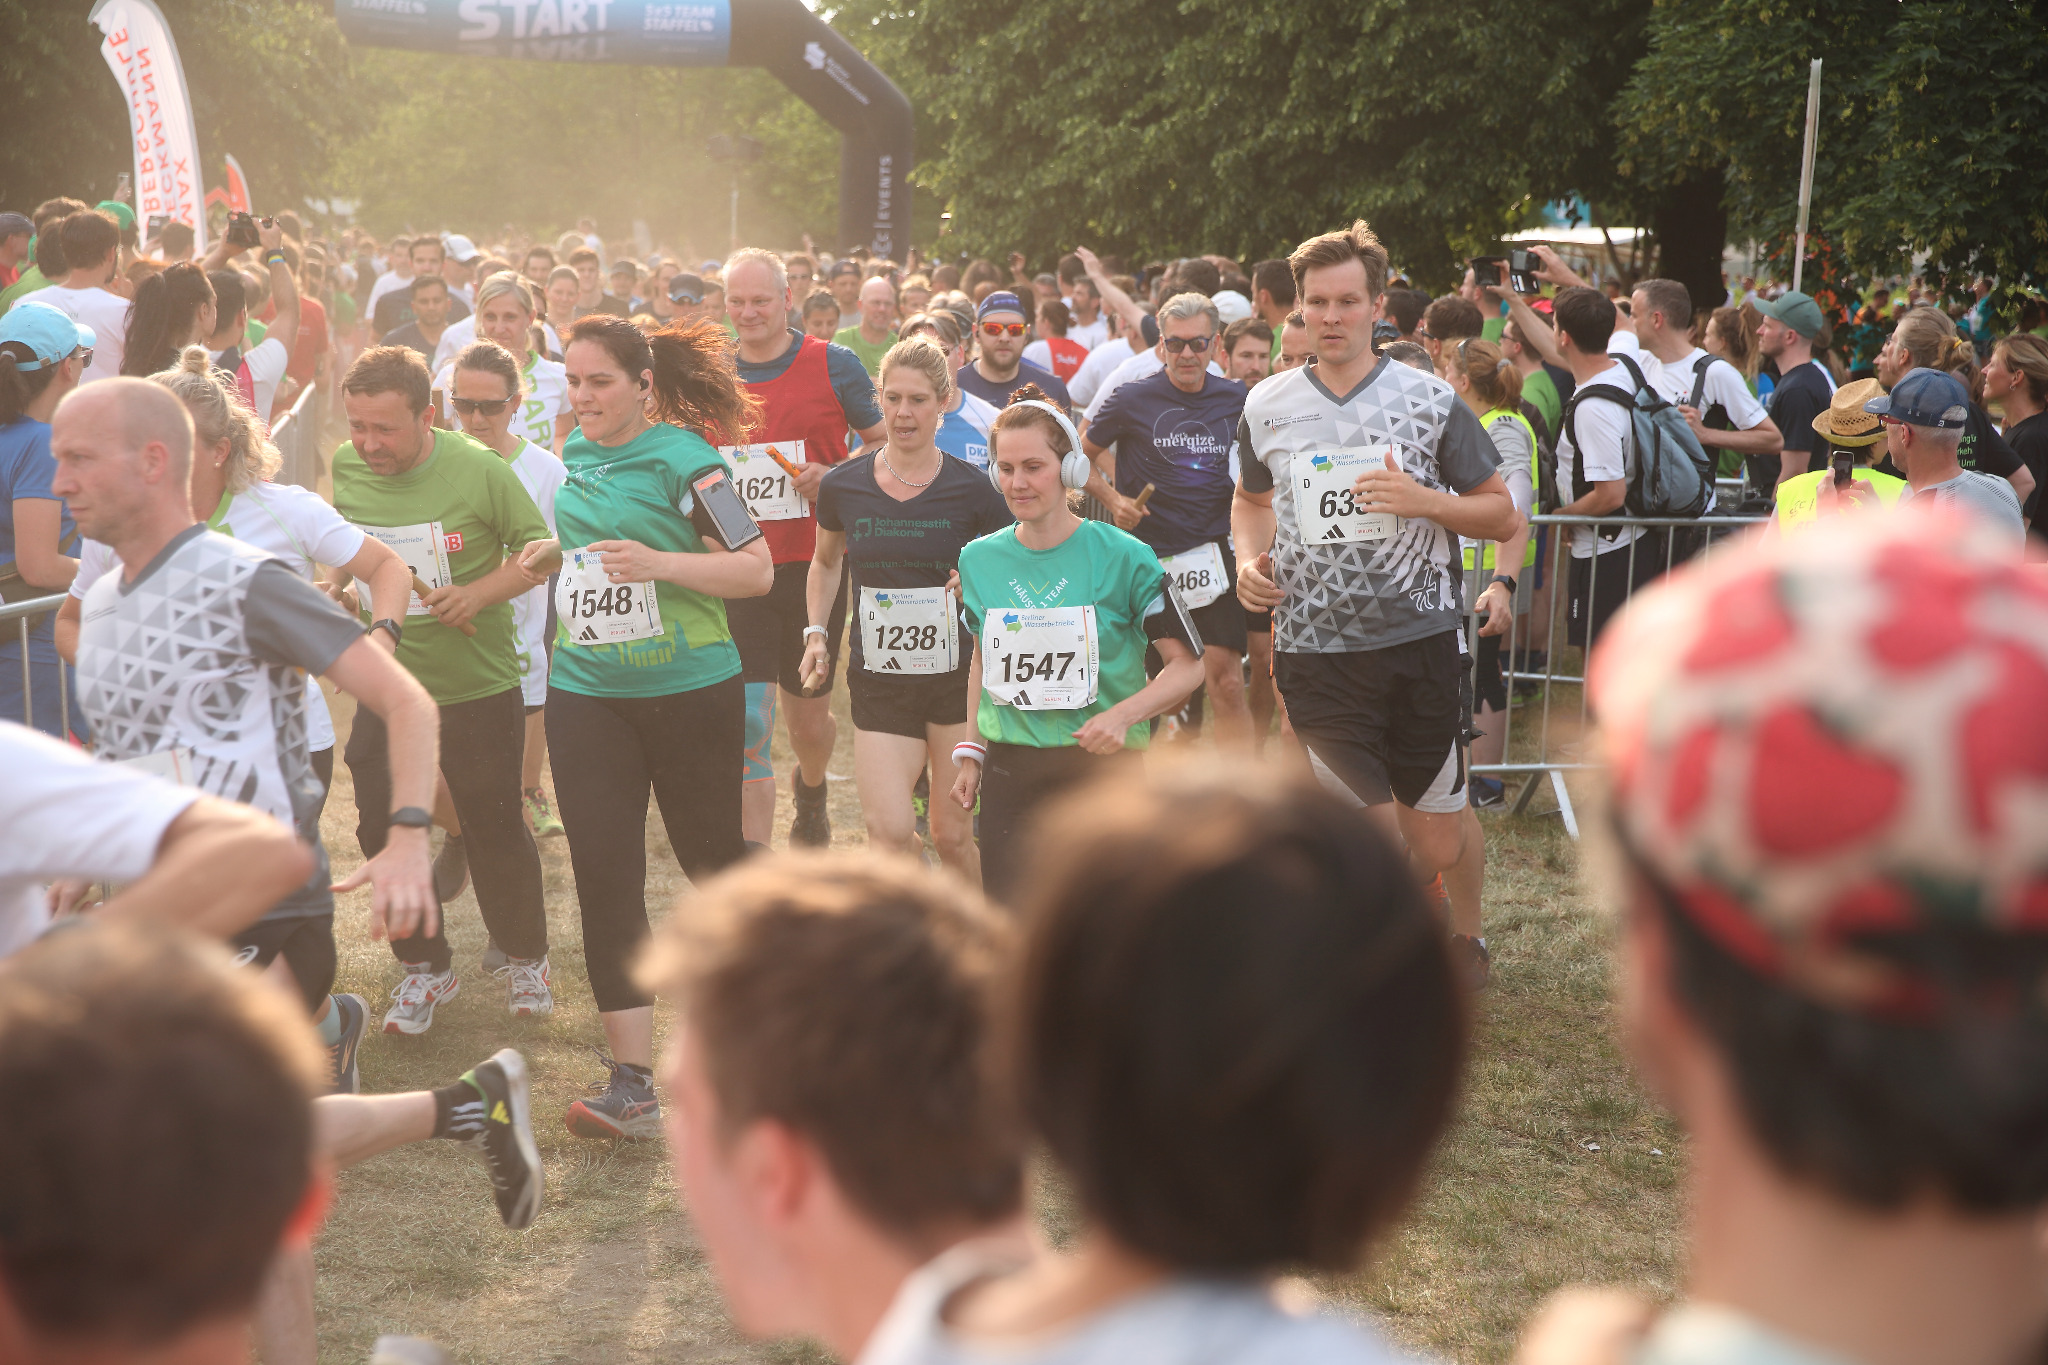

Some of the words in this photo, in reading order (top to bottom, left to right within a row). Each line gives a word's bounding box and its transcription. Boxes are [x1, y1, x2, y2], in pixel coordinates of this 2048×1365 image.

[458, 0, 614, 41] START
[643, 18, 699, 33] STAFFEL
[876, 155, 893, 220] EVENTS
[1153, 434, 1215, 450] energize
[1191, 444, 1227, 456] society
[1331, 453, 1355, 461] Berliner
[1336, 457, 1382, 467] Wasserbetriebe
[736, 475, 786, 501] 1621
[1303, 478, 1311, 489] D
[874, 517, 952, 529] Johannesstift
[874, 527, 925, 538] Diakonie
[582, 551, 605, 559] Berline
[1008, 578, 1017, 587] 2
[1176, 569, 1211, 592] 468
[1039, 600, 1047, 609] 1
[1045, 577, 1069, 602] TEAM
[570, 586, 632, 619] 1548
[637, 600, 644, 613] 1
[869, 610, 875, 621] D
[1024, 620, 1075, 628] Wasserbetriebe
[875, 624, 938, 651] 1238
[940, 638, 946, 650] 1
[993, 637, 1000, 649] D
[1001, 651, 1076, 683] 1547
[1078, 667, 1084, 681] 1
